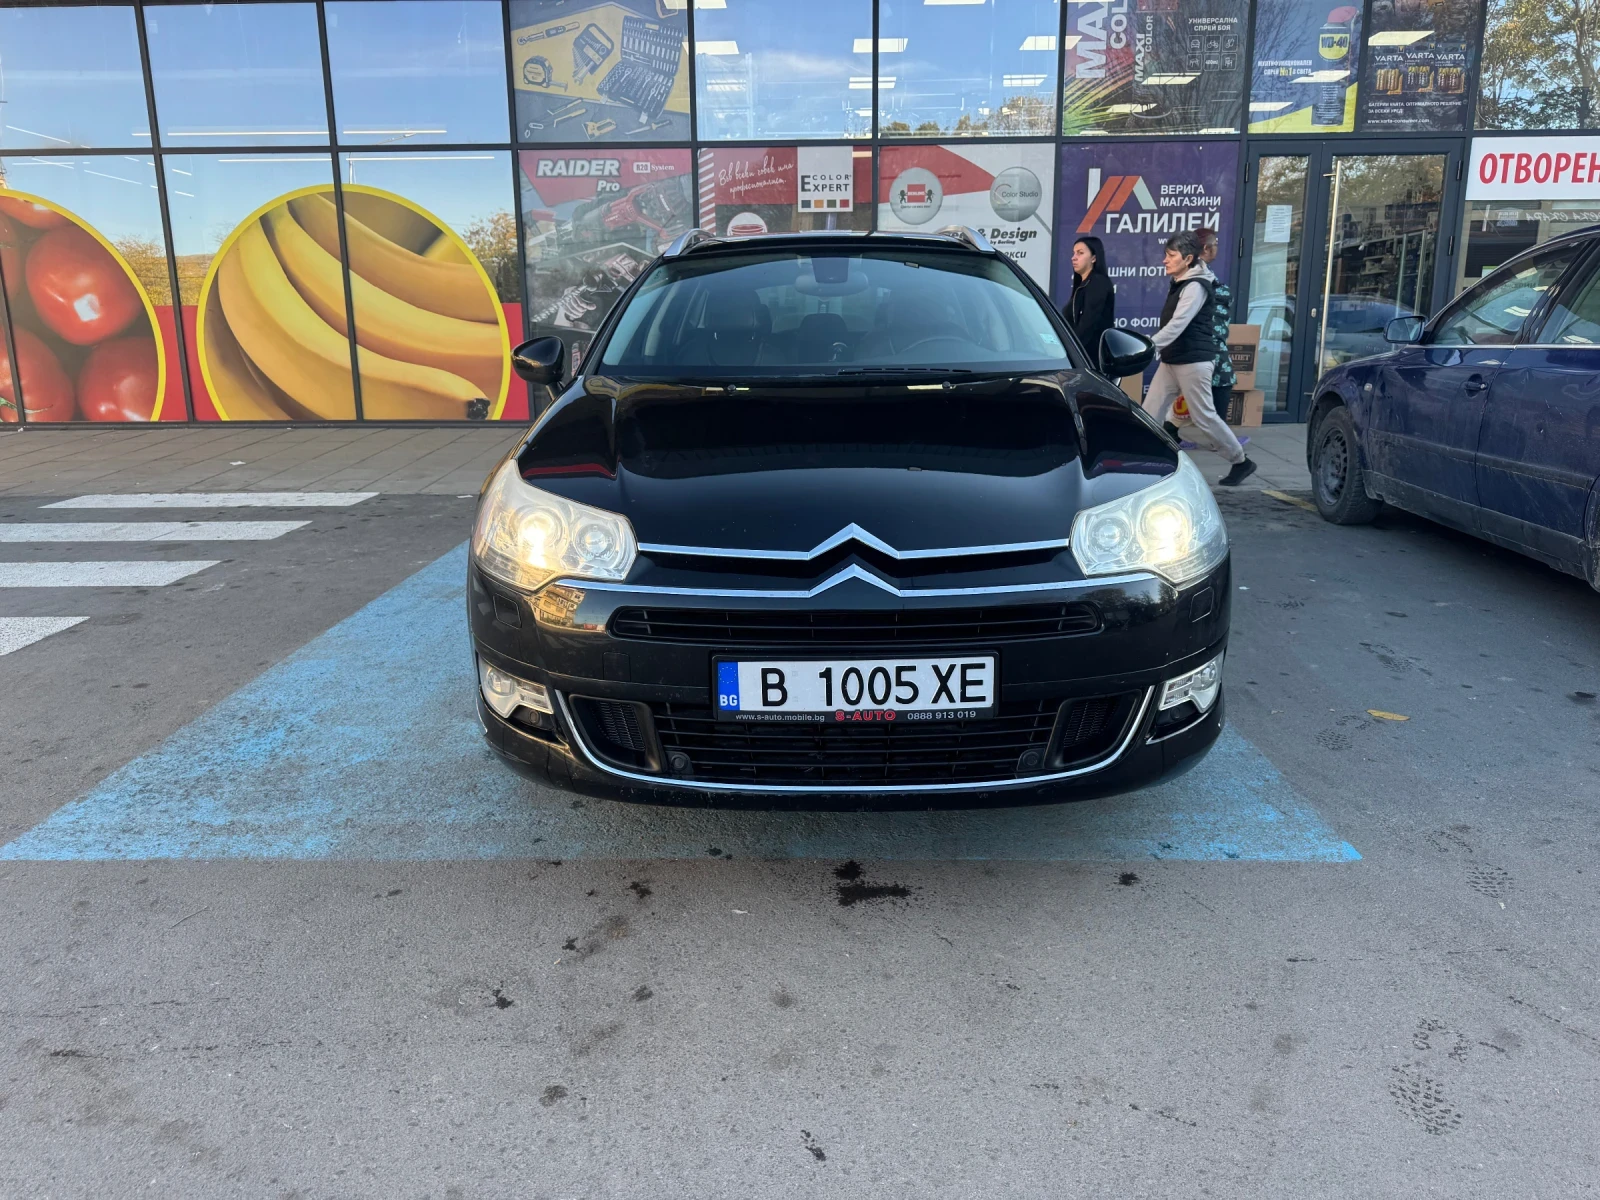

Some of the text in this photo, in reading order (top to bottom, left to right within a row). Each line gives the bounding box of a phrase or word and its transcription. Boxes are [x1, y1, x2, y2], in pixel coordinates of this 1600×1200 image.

[1193, 23, 1217, 31] СПРЕЙ
[1144, 15, 1154, 53] COLOR
[1321, 36, 1348, 48] WD-40
[1134, 33, 1145, 82] MAXI
[536, 159, 621, 177] RAIDER
[635, 163, 675, 172] R20 System
[1479, 152, 1600, 185] ОТВОРЕН
[597, 180, 620, 192] Pro
[1160, 184, 1205, 195] ВЕРИГА
[1019, 190, 1039, 198] Studio
[1159, 196, 1221, 207] МАГАЗИНИ
[1105, 207, 1220, 234] ГАЛИЛЕЙ
[990, 227, 1037, 242] Design
[761, 662, 987, 707] B 1005 XE
[719, 694, 738, 707] BG
[735, 710, 976, 722] www.s-auto.mobile.bg S-AUTO 0888 913 019
